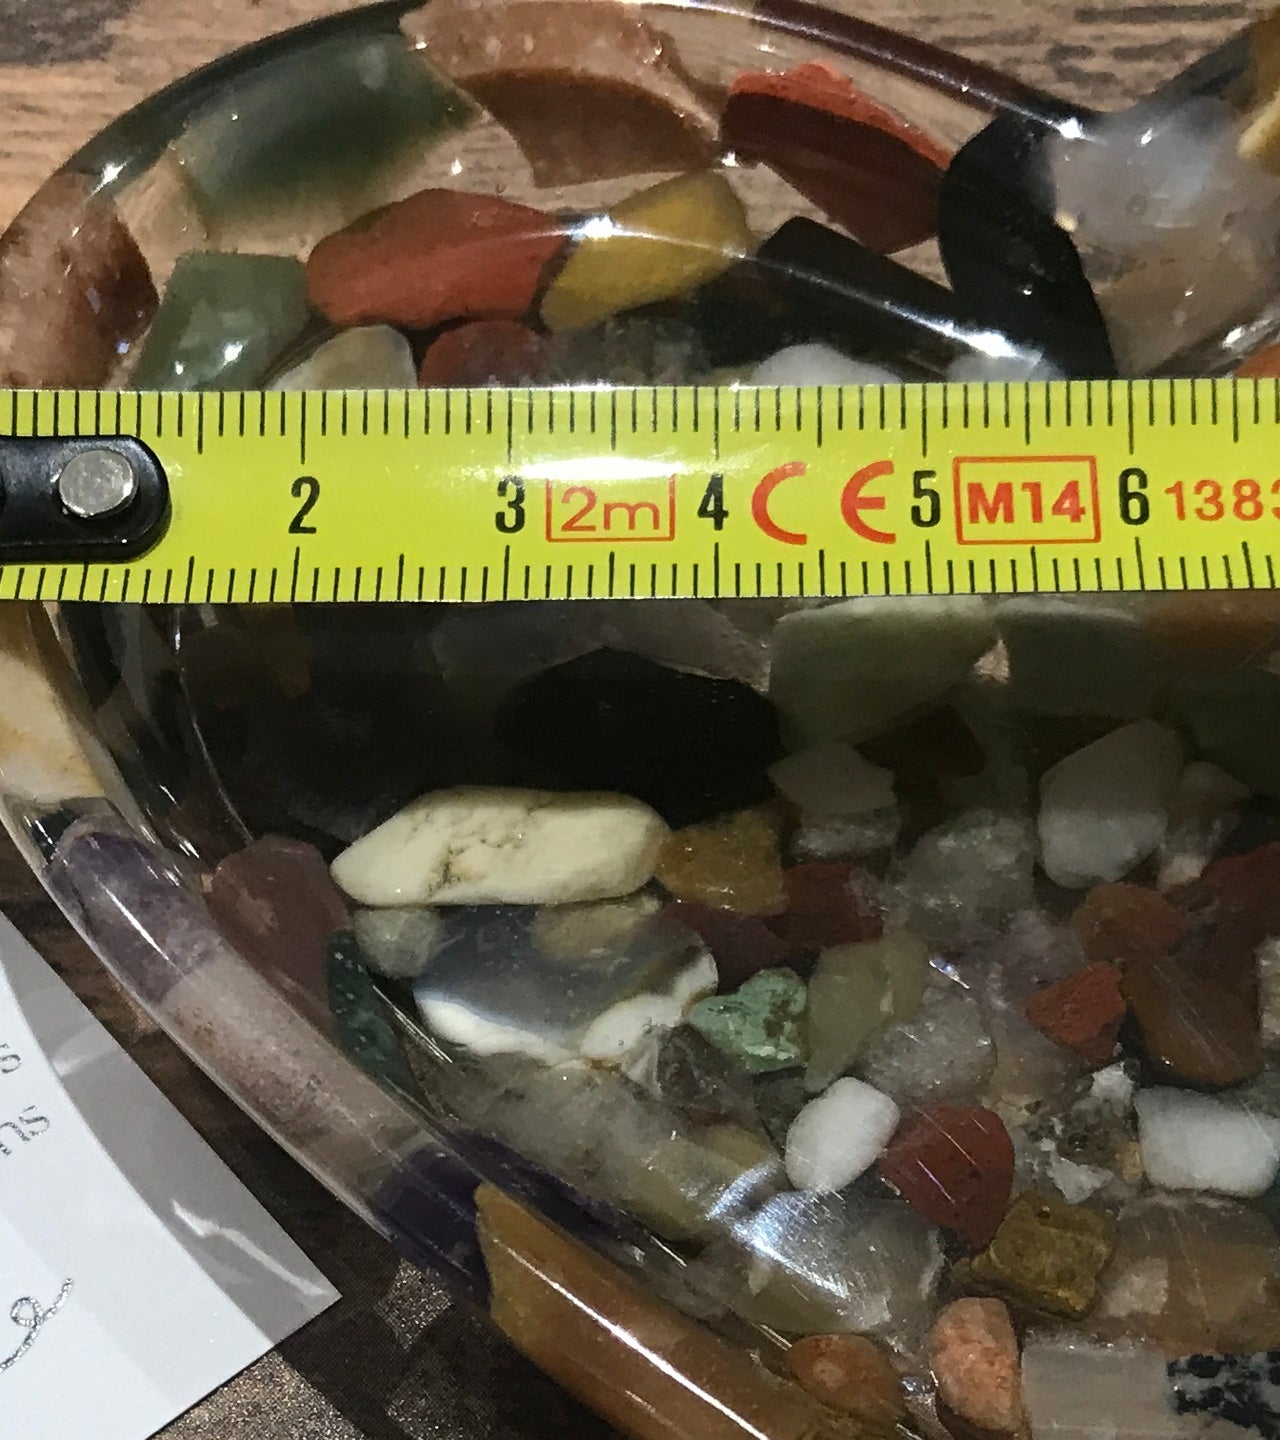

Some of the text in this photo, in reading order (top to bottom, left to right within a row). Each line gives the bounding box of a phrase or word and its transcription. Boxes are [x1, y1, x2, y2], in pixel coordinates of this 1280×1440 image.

[290, 475, 319, 534] 2
[496, 475, 525, 533] 3
[562, 486, 661, 531] 2m
[697, 475, 728, 530] 4
[912, 471, 941, 527] 5
[968, 481, 1085, 525] M14
[1121, 469, 1150, 525] 6
